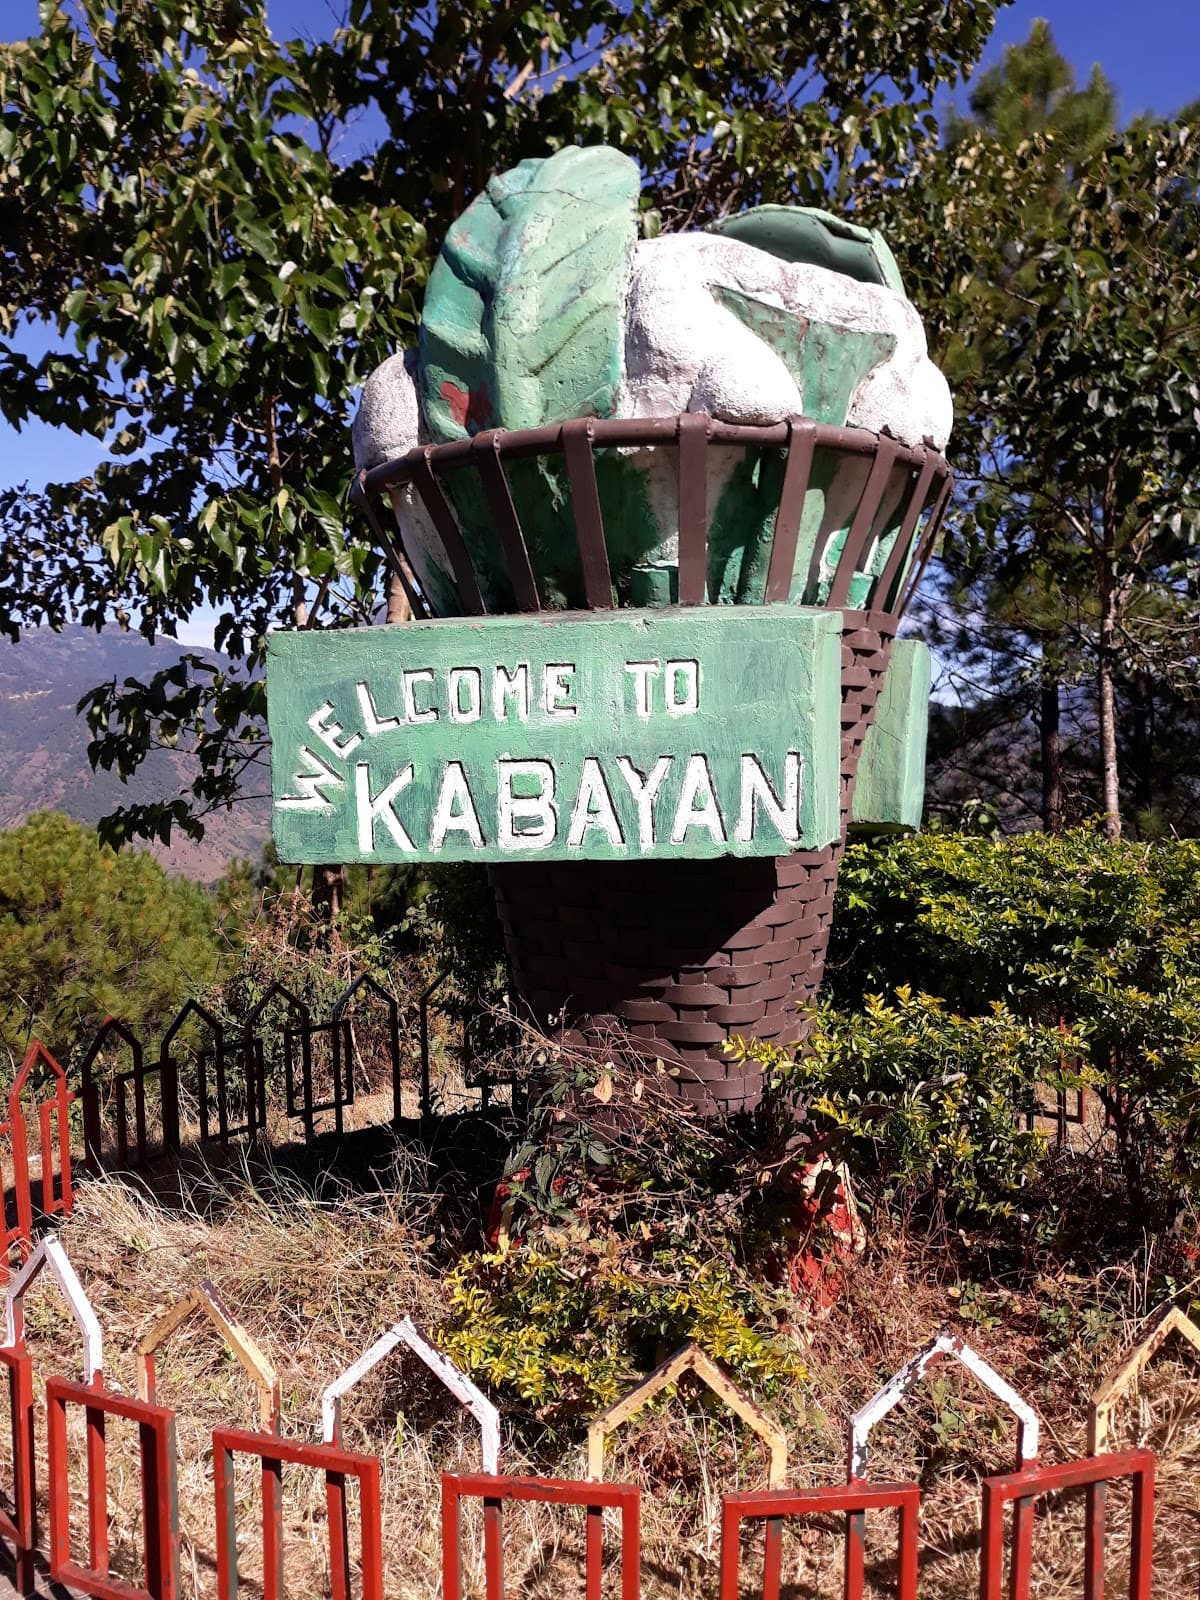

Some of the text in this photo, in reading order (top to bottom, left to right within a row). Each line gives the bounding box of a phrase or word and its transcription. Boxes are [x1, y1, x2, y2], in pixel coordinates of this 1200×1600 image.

[274, 658, 702, 814] WELCOME TO
[354, 752, 804, 855] KABAYAN
